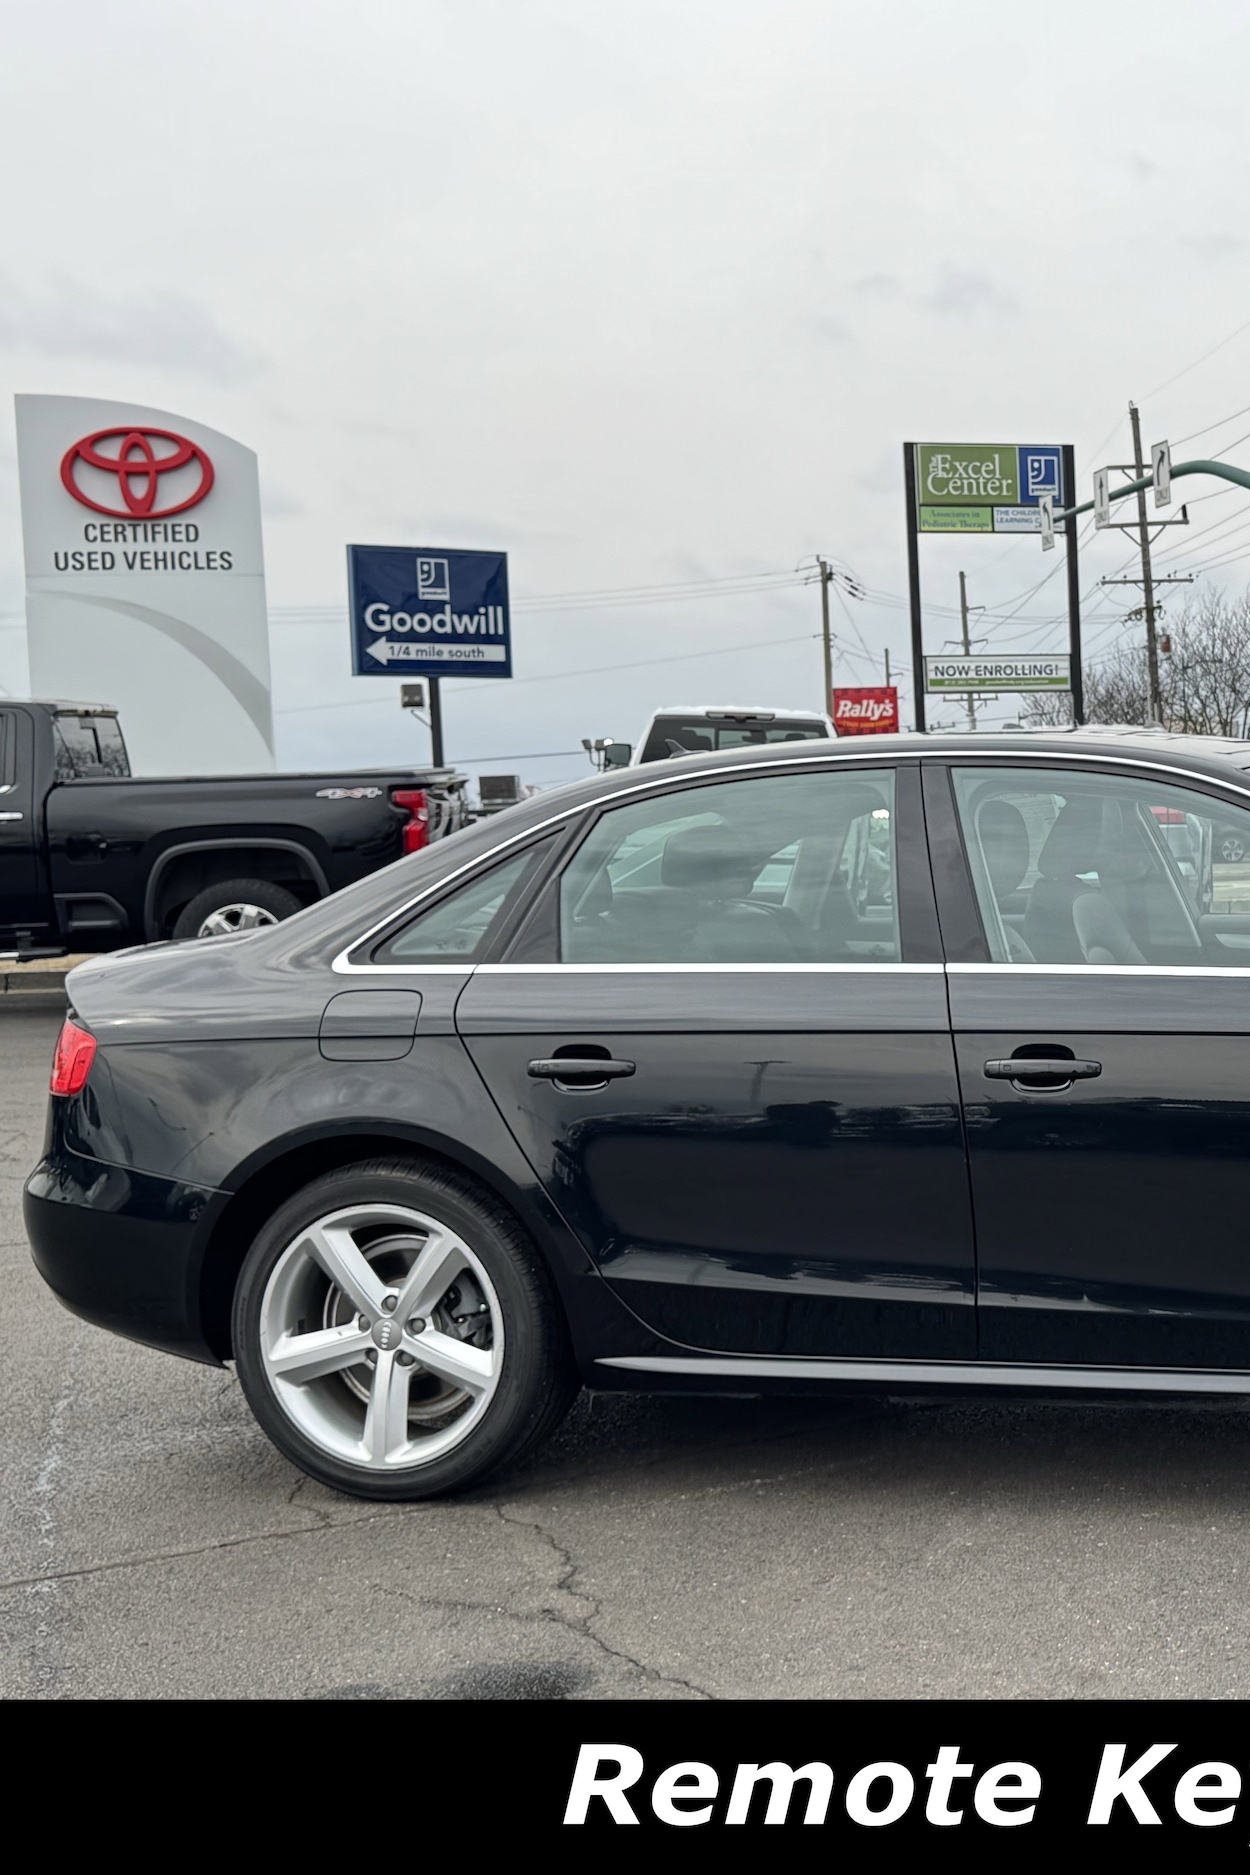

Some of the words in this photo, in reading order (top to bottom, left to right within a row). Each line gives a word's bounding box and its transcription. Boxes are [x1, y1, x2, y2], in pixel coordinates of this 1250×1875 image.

[935, 453, 1002, 478] Excel
[926, 471, 1013, 496] Center
[83, 523, 200, 544] CERTIFIED
[54, 551, 116, 572] USED
[123, 550, 234, 571] VEHICLES
[364, 602, 505, 636] Goodwill
[389, 645, 412, 658] 1/4
[415, 645, 444, 658] mile
[447, 647, 485, 659] south
[934, 665, 970, 677] NOW
[974, 664, 1059, 676] ENROLLING!
[835, 699, 894, 721] Rally's
